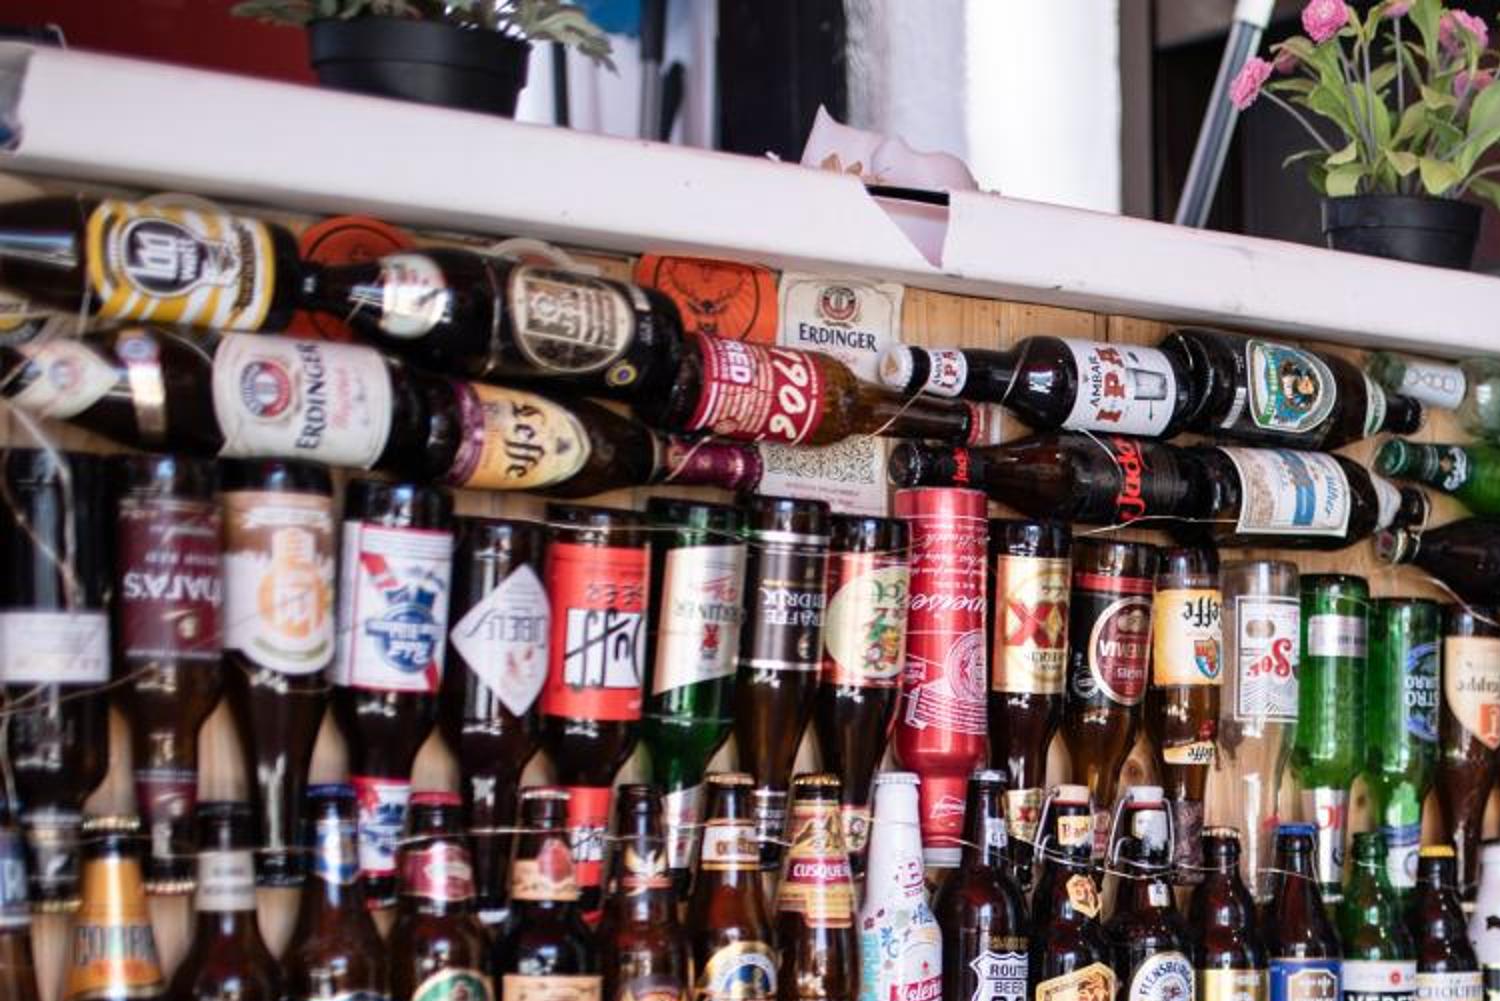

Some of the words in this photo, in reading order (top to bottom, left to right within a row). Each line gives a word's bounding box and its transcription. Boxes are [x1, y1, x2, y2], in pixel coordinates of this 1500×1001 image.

[798, 322, 878, 353] ERDINGER
[296, 344, 327, 452] ERDINGER
[767, 349, 810, 441] 1906
[1182, 598, 1220, 627] effe
